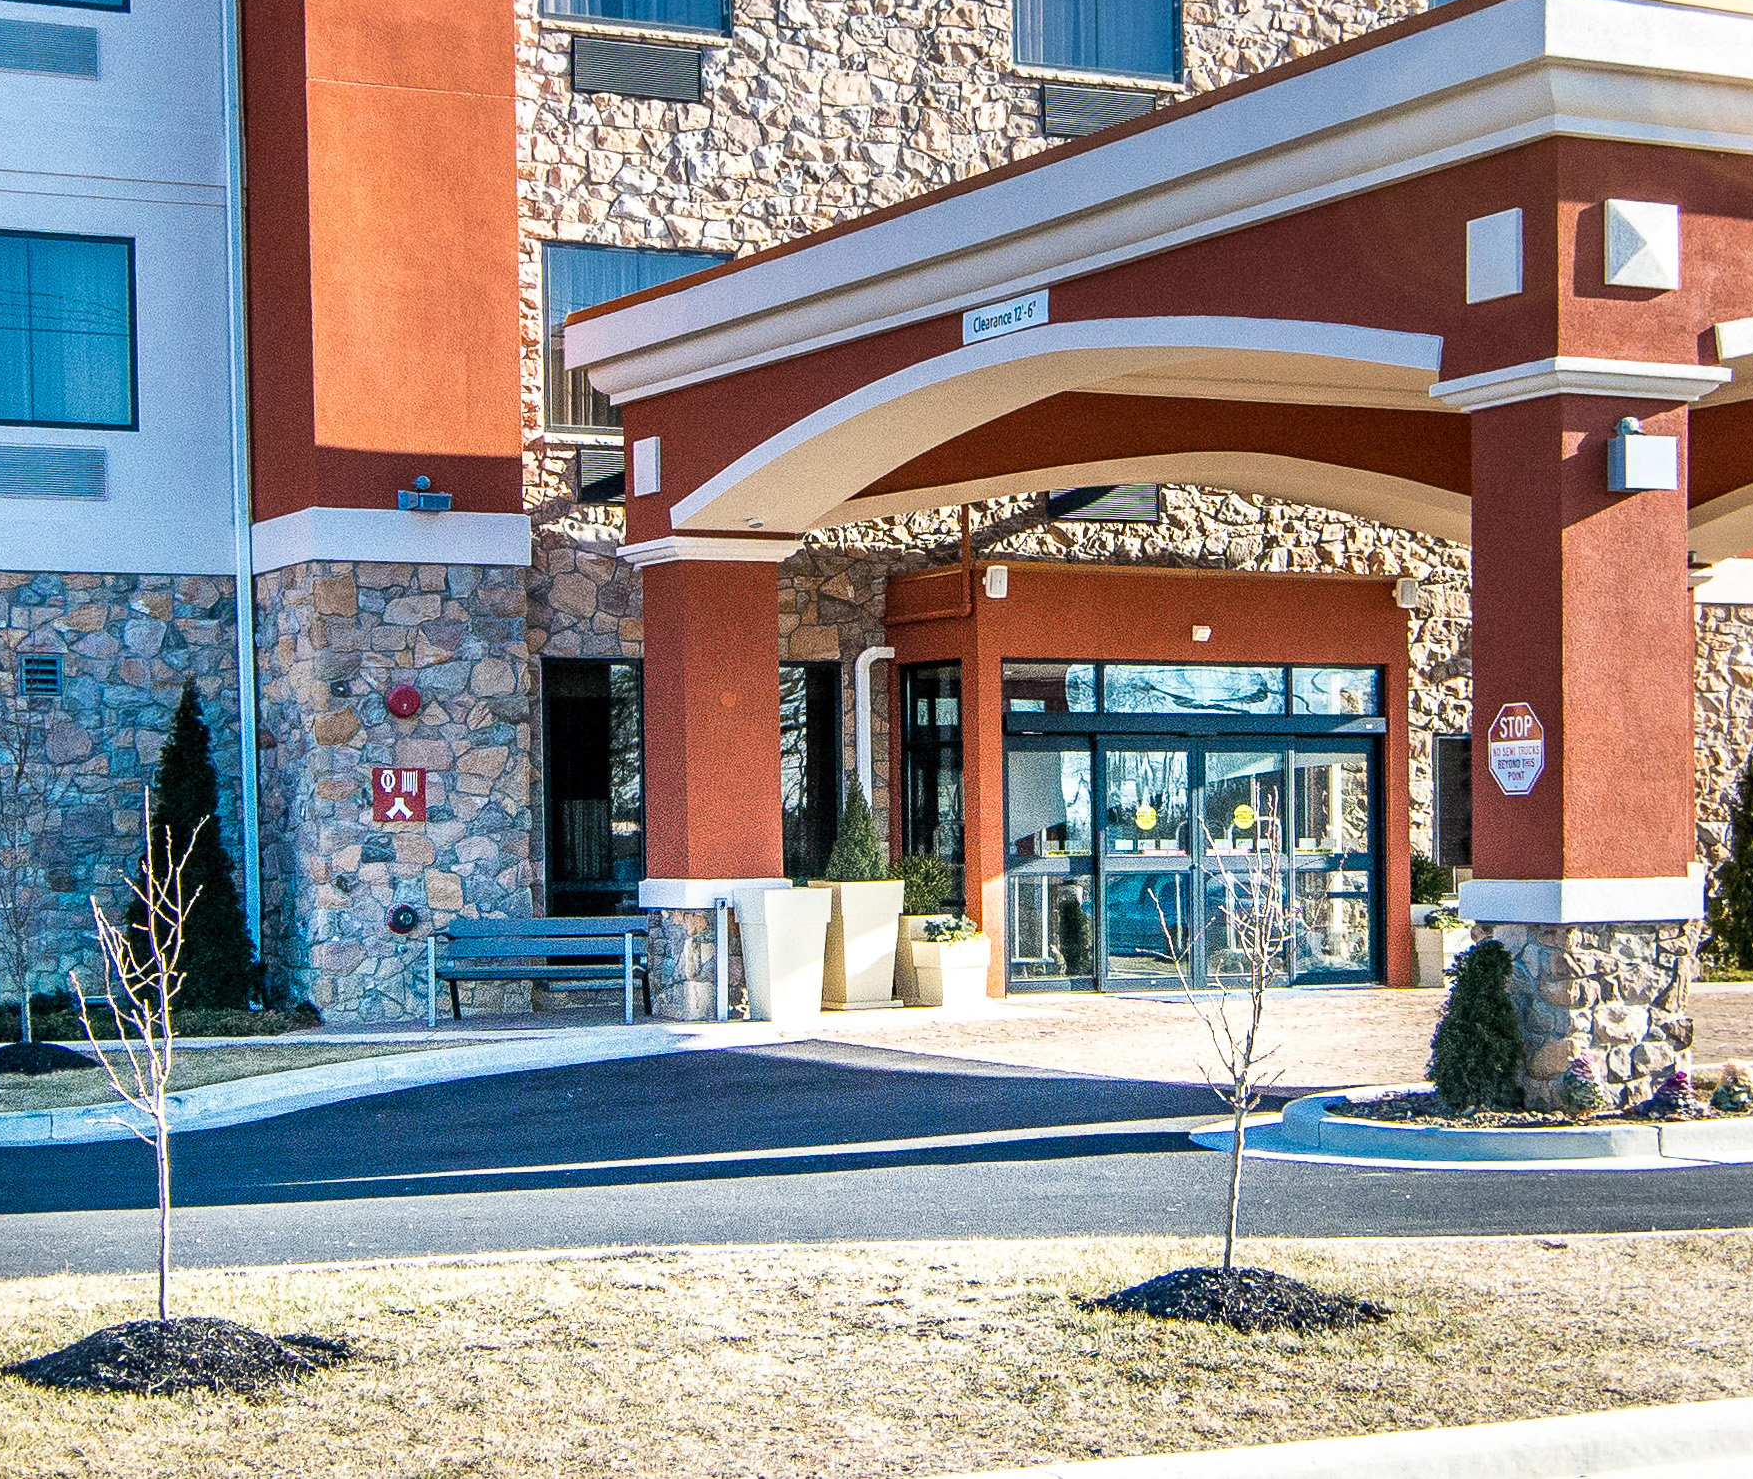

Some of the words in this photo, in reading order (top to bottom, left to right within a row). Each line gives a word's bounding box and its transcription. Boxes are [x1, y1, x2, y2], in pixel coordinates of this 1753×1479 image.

[973, 311, 1012, 333] Clearance
[1499, 715, 1533, 739] STOP
[1493, 747, 1501, 757] NO
[1502, 746, 1516, 757] SEMI
[1518, 745, 1540, 756] TRUCKS
[1498, 759, 1521, 770] BEYOND
[1507, 770, 1525, 781] POINT
